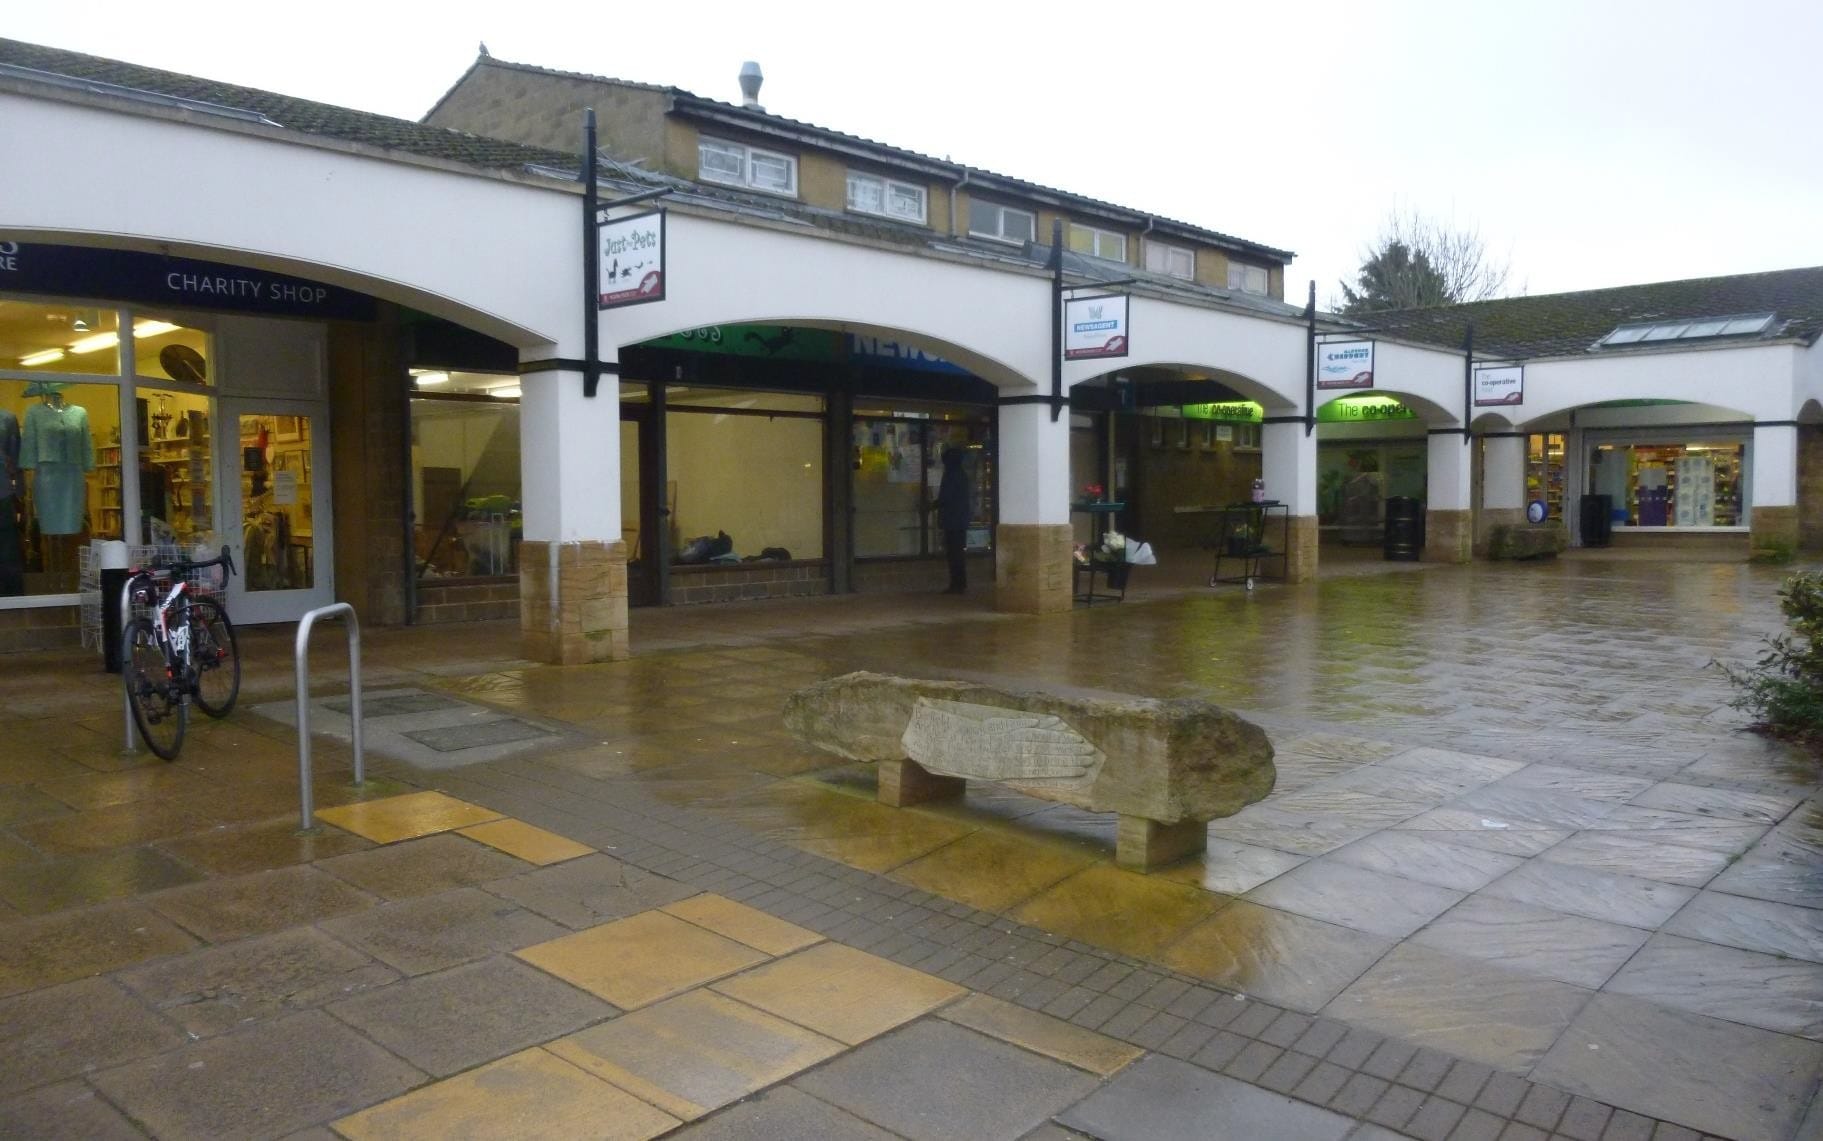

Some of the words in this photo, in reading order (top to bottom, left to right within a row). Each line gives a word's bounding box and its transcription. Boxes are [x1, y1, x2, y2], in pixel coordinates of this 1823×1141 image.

[604, 235, 626, 257] Just
[631, 229, 657, 251] Pets
[167, 272, 262, 298] CHARITY
[271, 283, 327, 303] SHOP
[1211, 404, 1255, 417] co-operative
[1338, 403, 1359, 417] The
